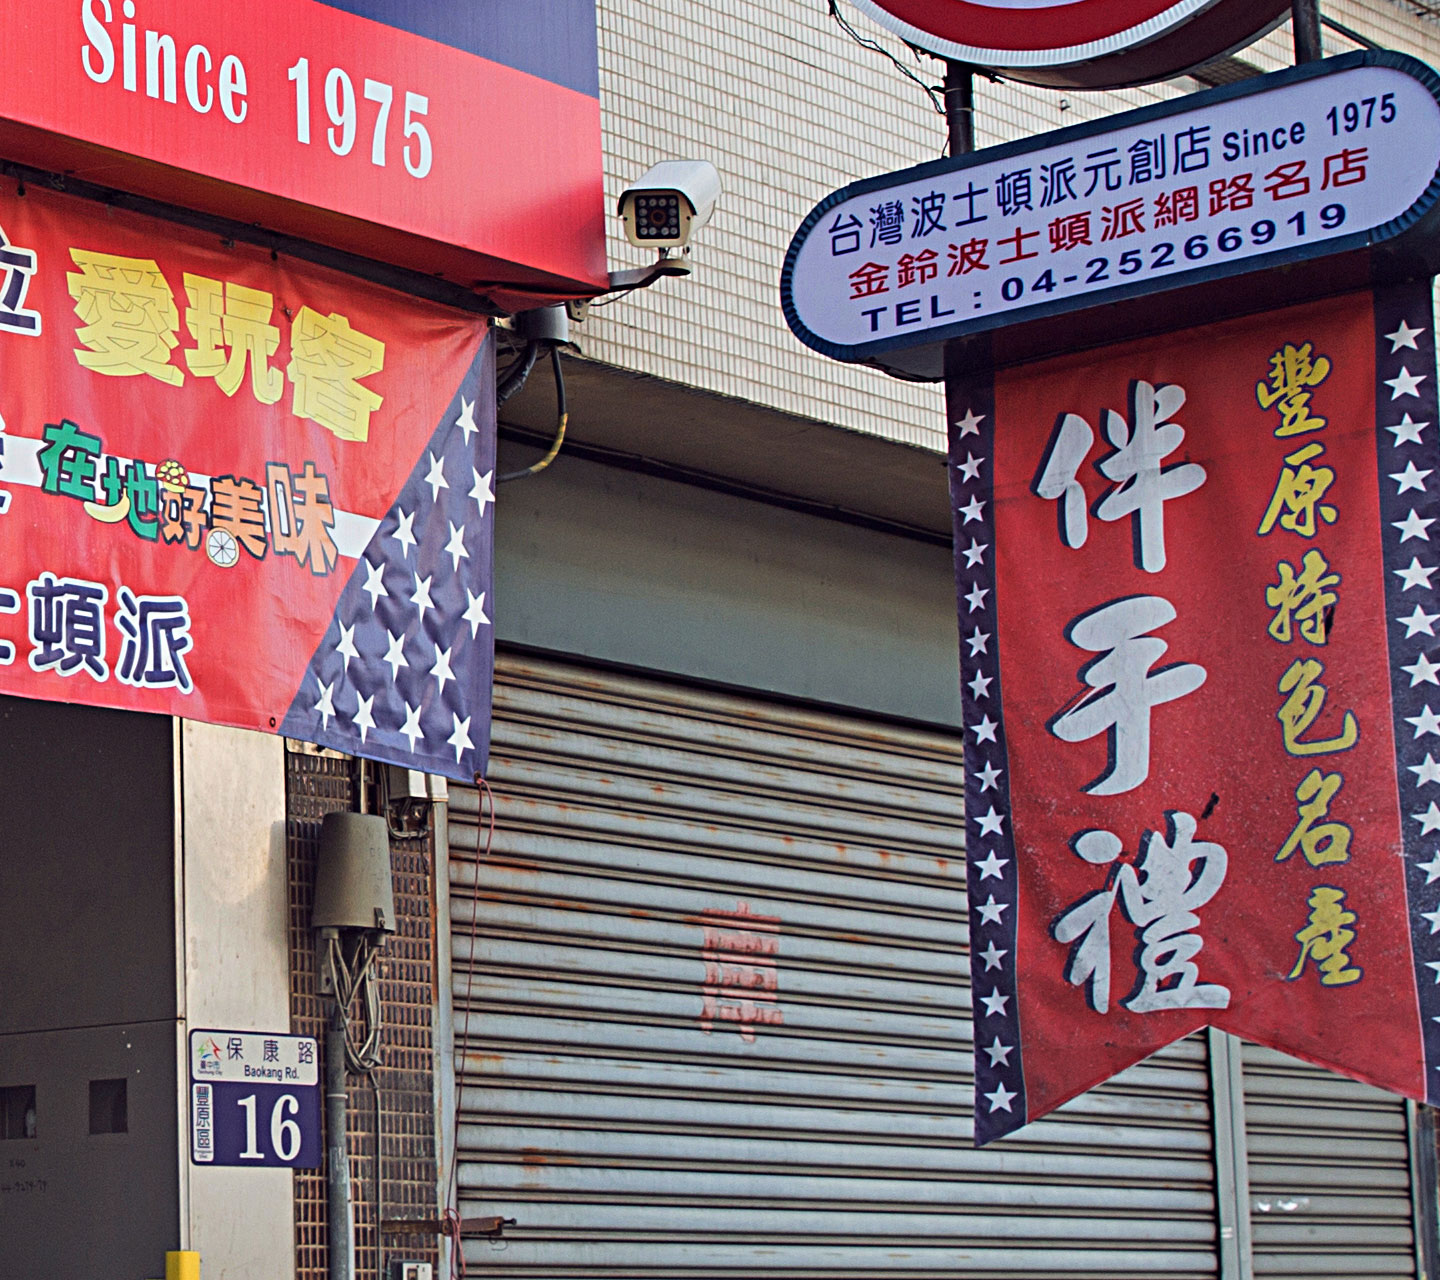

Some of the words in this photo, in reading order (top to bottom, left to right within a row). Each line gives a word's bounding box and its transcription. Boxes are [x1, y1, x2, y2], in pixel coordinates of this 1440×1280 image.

[287, 57, 434, 180] 1975
[827, 125, 1211, 258] 台灣波士頓派元創店
[1222, 118, 1306, 163] Since
[1325, 92, 1398, 139] 1975
[848, 146, 1370, 301] 金鈴波士頓派網路名店
[67, 245, 389, 444] 愛玩客
[37, 418, 339, 577] 在地好美味
[1032, 376, 1232, 1016] 伴手禮
[1256, 340, 1366, 988] 豐原特色名產
[227, 1037, 313, 1064] 保康路
[238, 1094, 301, 1161] 16
[244, 1065, 283, 1081] Baokang
[285, 1067, 299, 1079] Rd.
